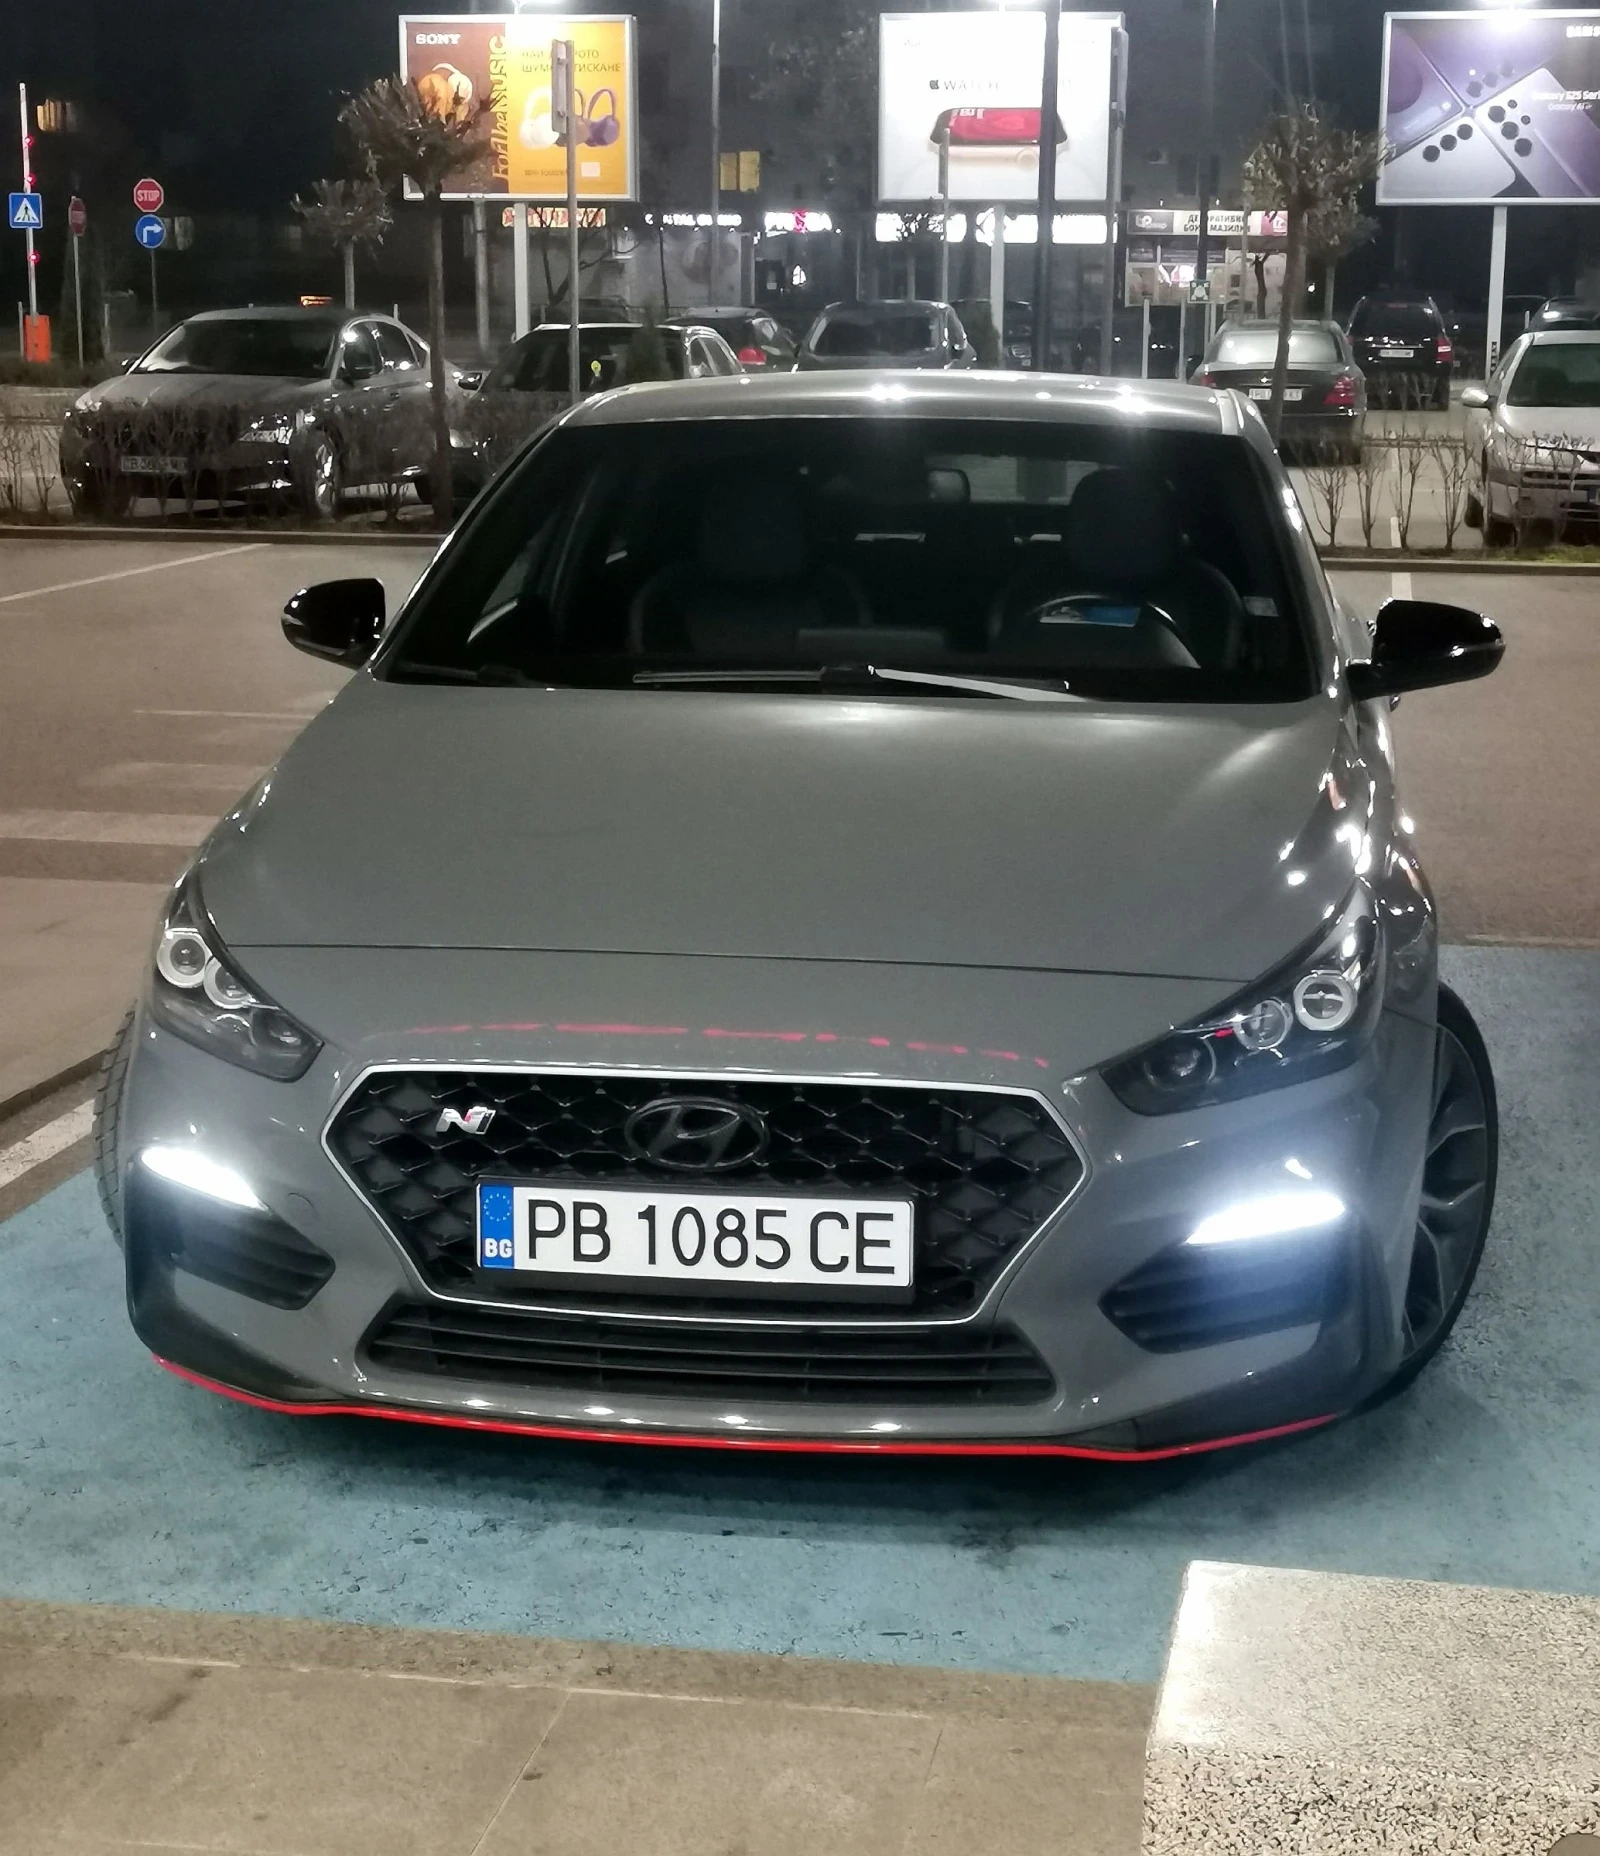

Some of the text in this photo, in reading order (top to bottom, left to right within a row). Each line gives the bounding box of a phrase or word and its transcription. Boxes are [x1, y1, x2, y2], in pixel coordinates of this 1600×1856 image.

[415, 33, 462, 45] SONY
[137, 189, 160, 202] STOP
[484, 1198, 896, 1275] BG PB 1085 CE
